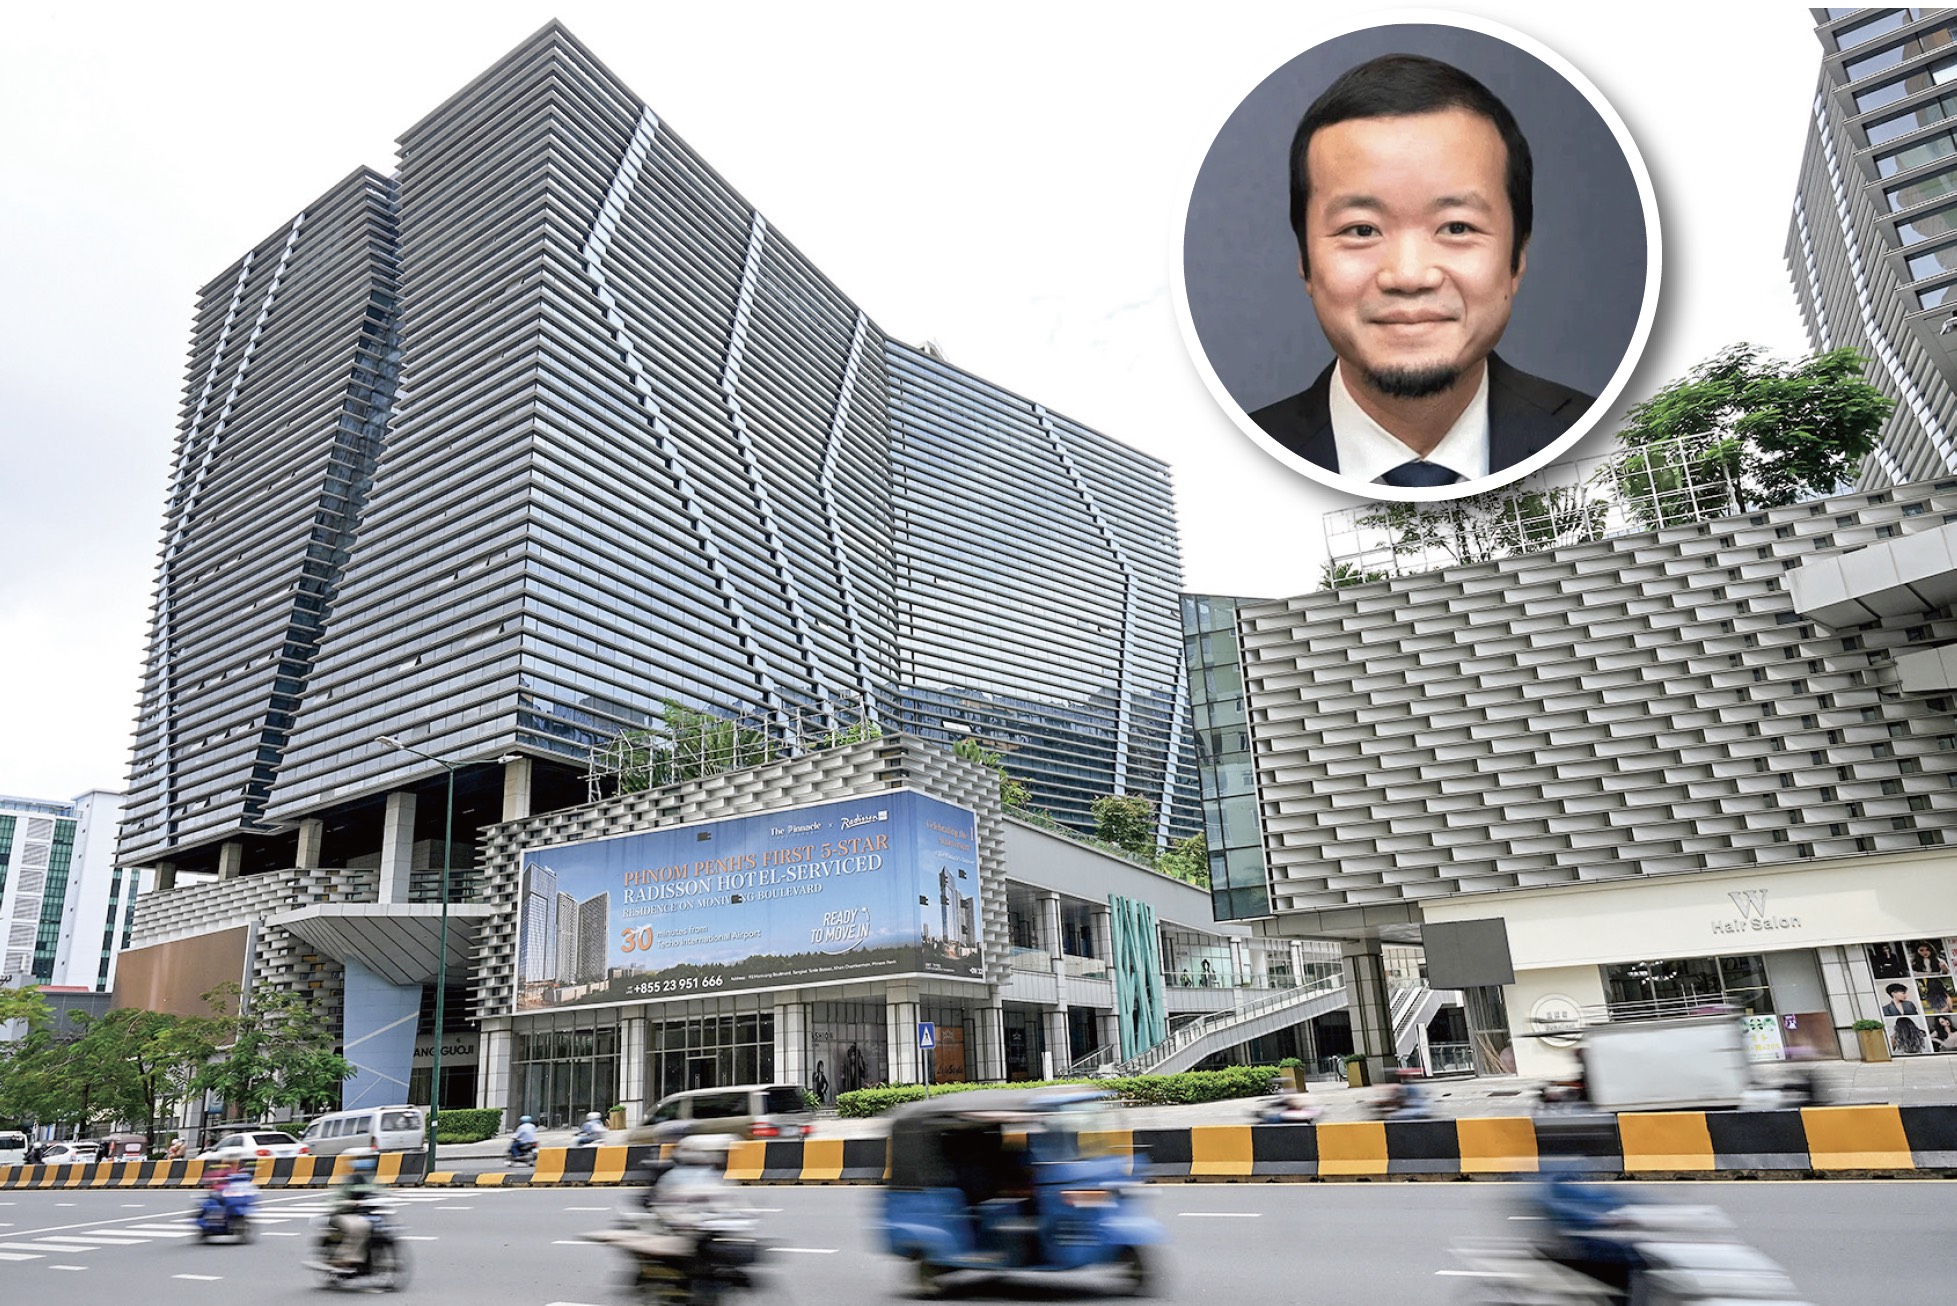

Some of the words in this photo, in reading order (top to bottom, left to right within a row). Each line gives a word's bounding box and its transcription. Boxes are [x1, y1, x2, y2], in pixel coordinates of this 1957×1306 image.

[770, 826, 785, 836] The
[787, 821, 822, 834] Pinnacle
[624, 863, 689, 887] PHNOM
[693, 853, 757, 878] PENH'S
[762, 845, 816, 868] FIRST
[821, 833, 889, 860] 5-STAR
[623, 878, 712, 905] RADISSON
[717, 853, 883, 892] HOTEL-SERVICED
[622, 902, 678, 918] RESIDENCE
[679, 900, 694, 912] ON
[698, 891, 755, 909] MONIVNG
[758, 883, 823, 900] BOULEVARD
[1727, 888, 1768, 919] W
[823, 908, 859, 927] READY
[1711, 919, 1747, 934] Hair
[1750, 915, 1802, 931] Salon
[621, 924, 653, 953] 30
[656, 928, 688, 939] minutes
[688, 925, 709, 935] from
[680, 931, 732, 947] International
[731, 929, 762, 943] Airport
[811, 927, 823, 944] TO
[825, 924, 857, 942] MOVE
[856, 922, 871, 939] IN
[634, 981, 661, 994] +855
[663, 978, 677, 991] 23
[679, 977, 699, 990] 951
[702, 974, 723, 988] 666
[440, 1044, 474, 1056] GUOJI
